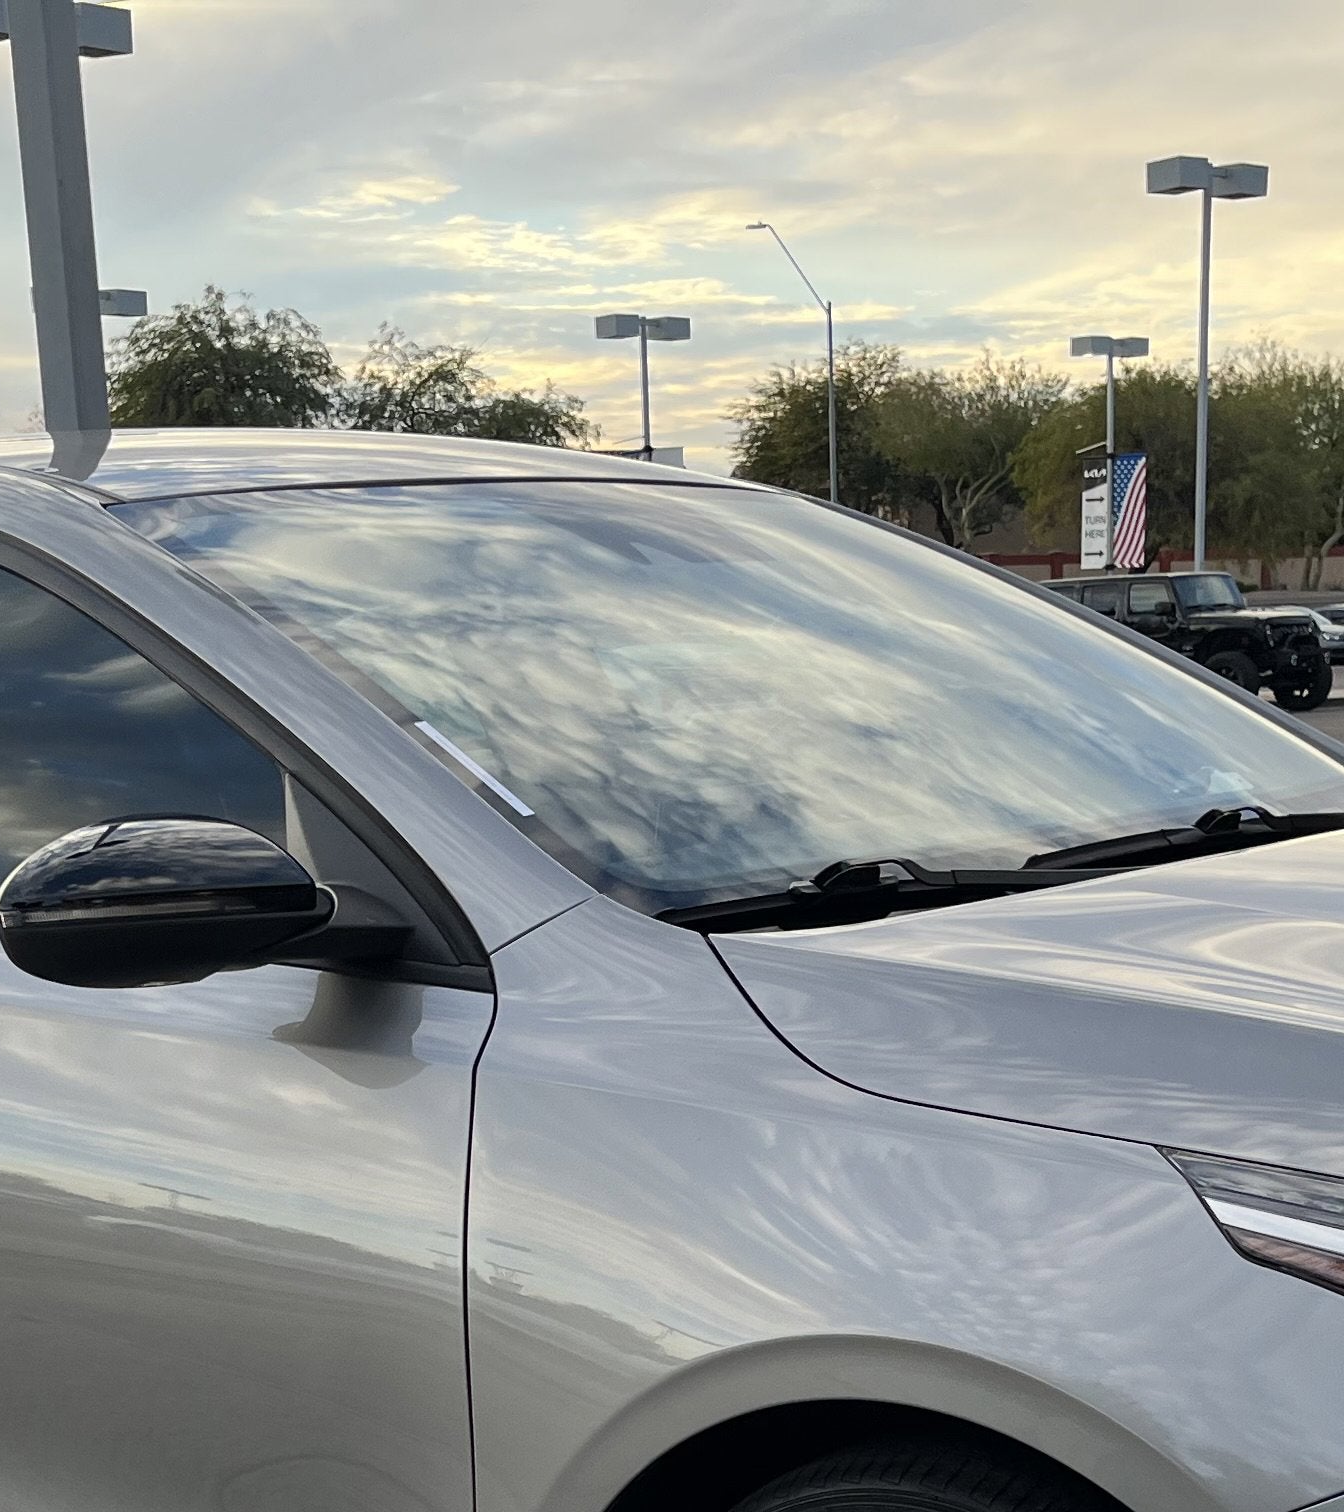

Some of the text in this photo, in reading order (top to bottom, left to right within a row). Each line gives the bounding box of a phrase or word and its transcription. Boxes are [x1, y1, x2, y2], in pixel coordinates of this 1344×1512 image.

[1084, 468, 1107, 478] KIA
[1085, 515, 1106, 525] TURN
[1084, 529, 1105, 539] HERE
